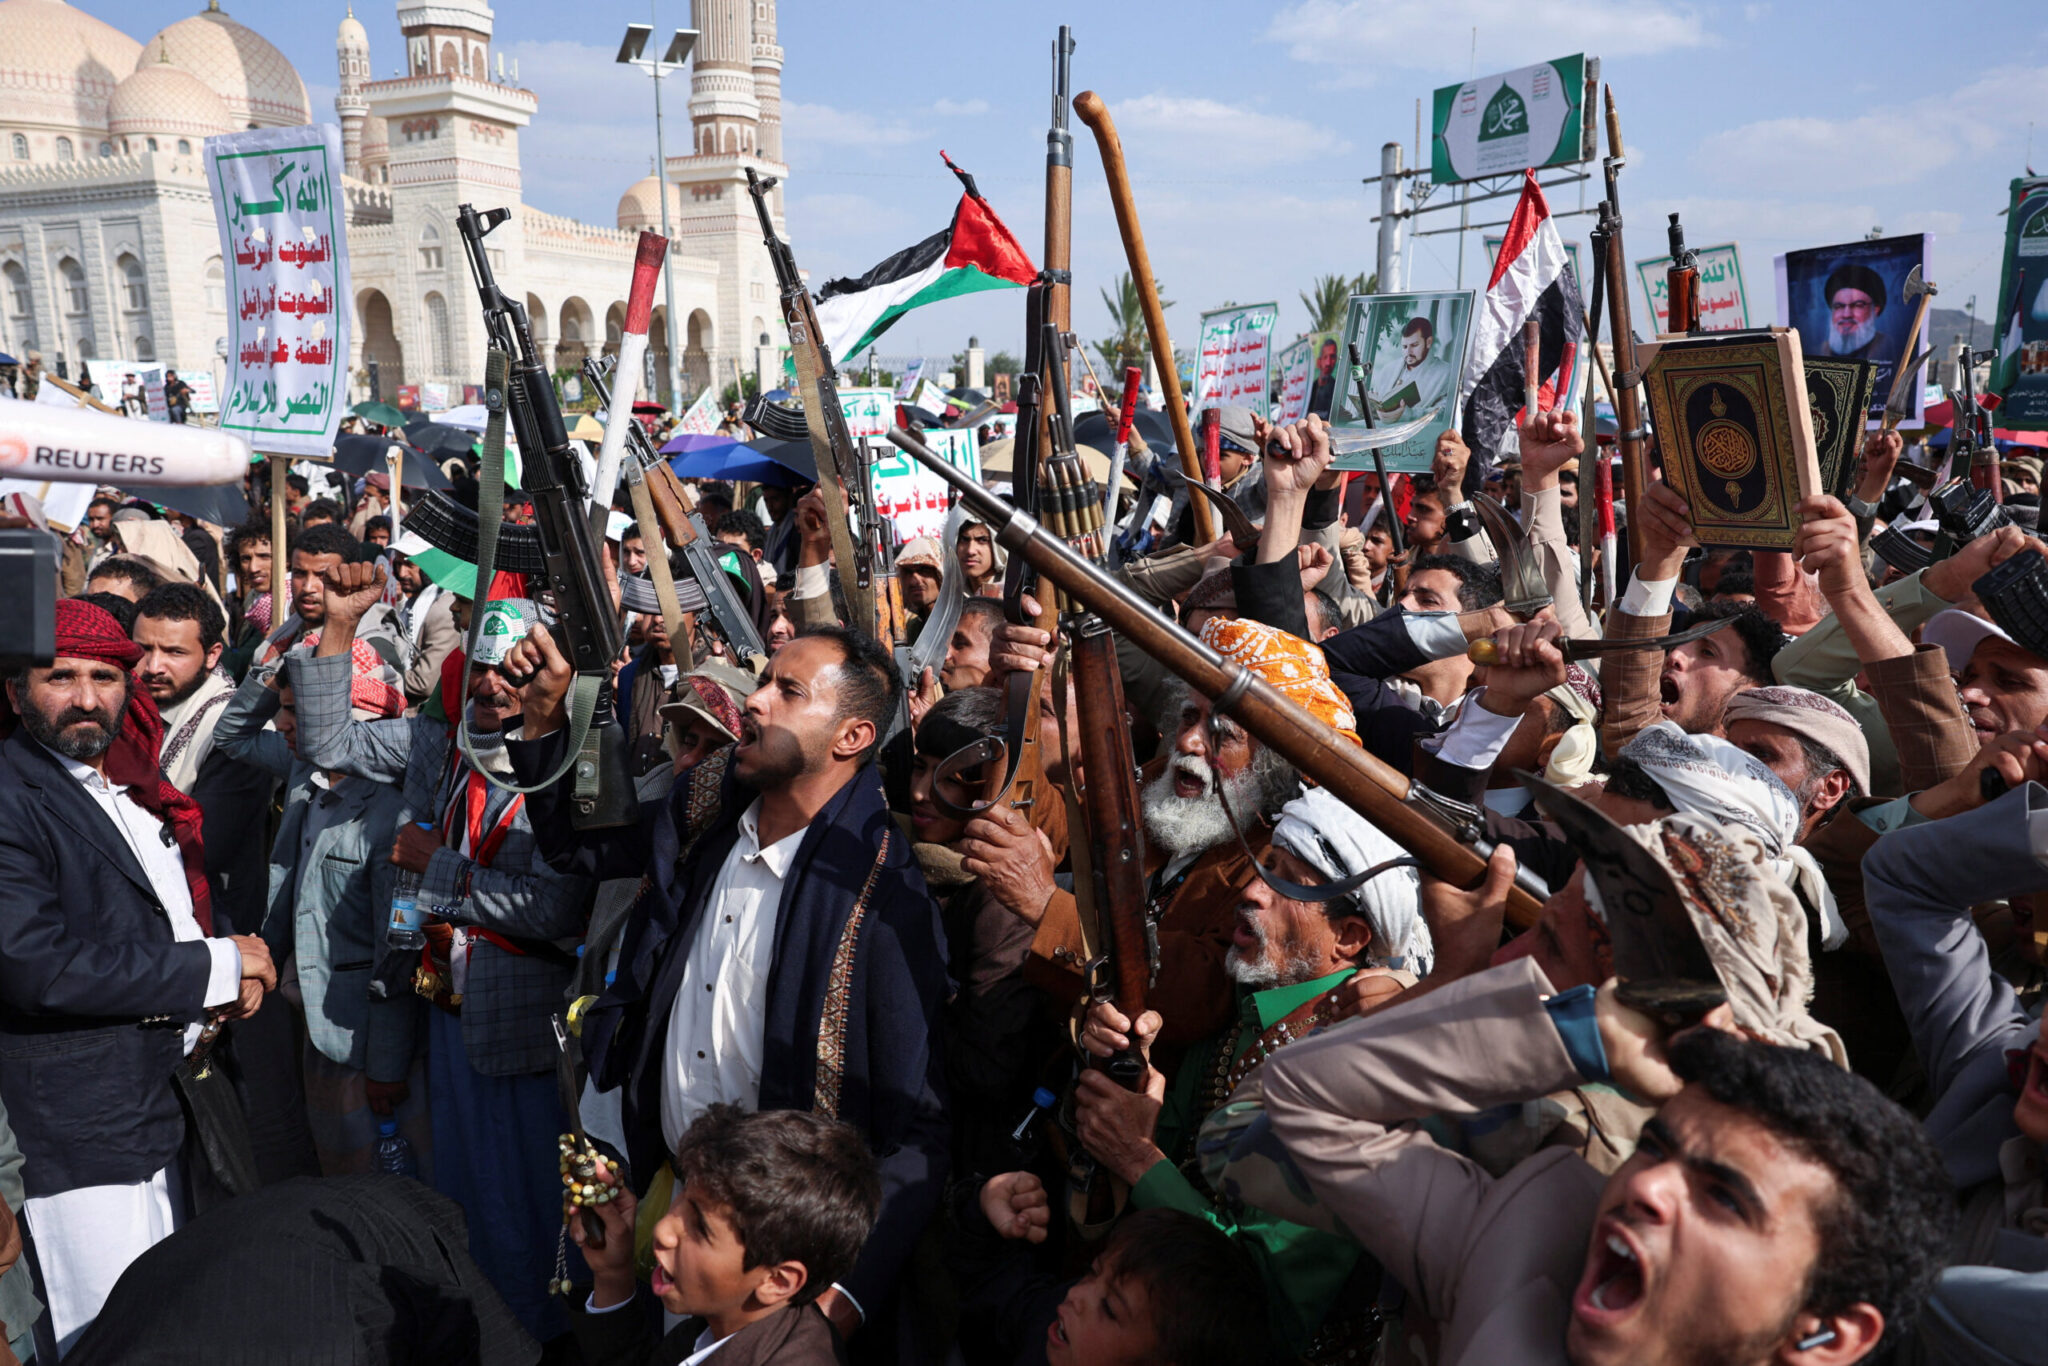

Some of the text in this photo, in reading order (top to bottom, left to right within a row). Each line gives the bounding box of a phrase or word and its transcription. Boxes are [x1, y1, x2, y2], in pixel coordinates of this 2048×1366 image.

[278, 233, 331, 269] الموت
[277, 286, 332, 320] الموت
[295, 336, 332, 365] اللعنة
[278, 380, 329, 424] النصر
[35, 446, 165, 475] REUTERS
